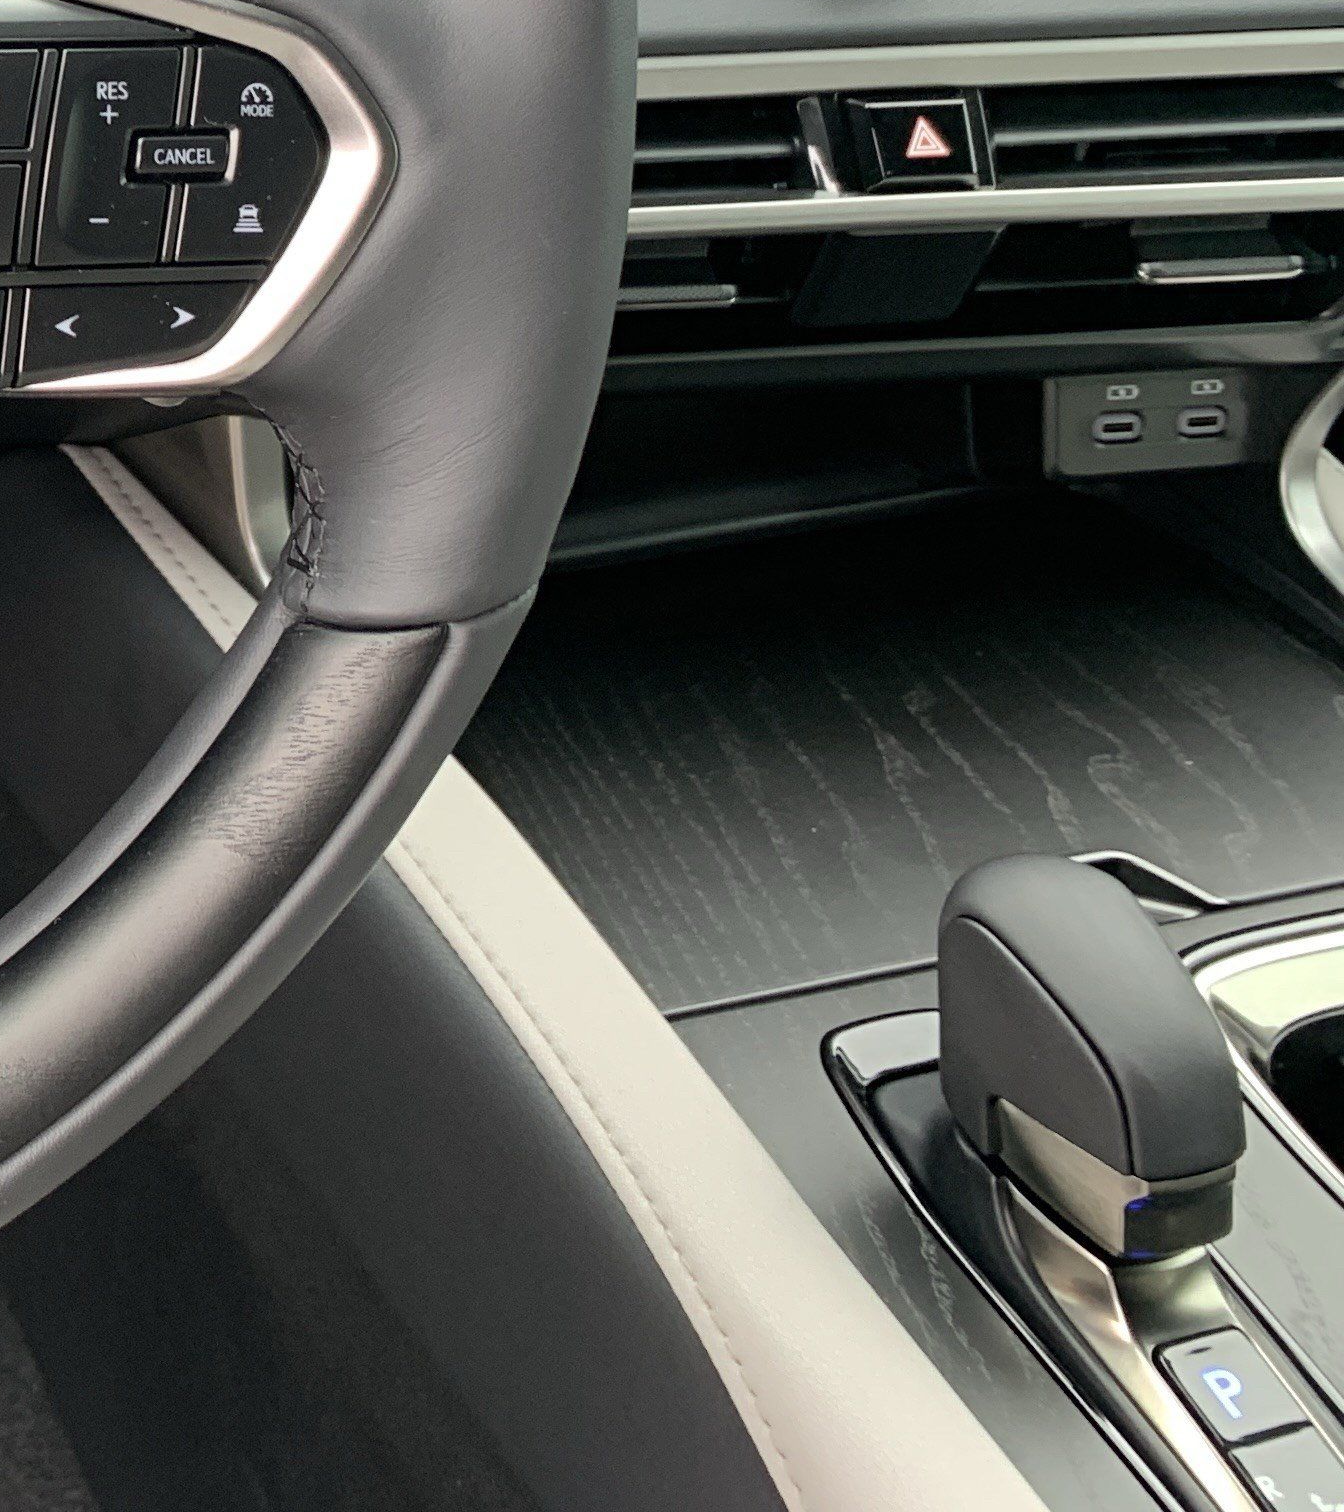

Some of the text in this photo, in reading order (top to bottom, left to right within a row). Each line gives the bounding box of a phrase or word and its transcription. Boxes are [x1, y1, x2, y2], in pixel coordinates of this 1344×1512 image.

[96, 80, 129, 102] RES
[240, 104, 275, 118] MODE
[153, 148, 216, 166] CANCEL
[1201, 1368, 1244, 1420] P
